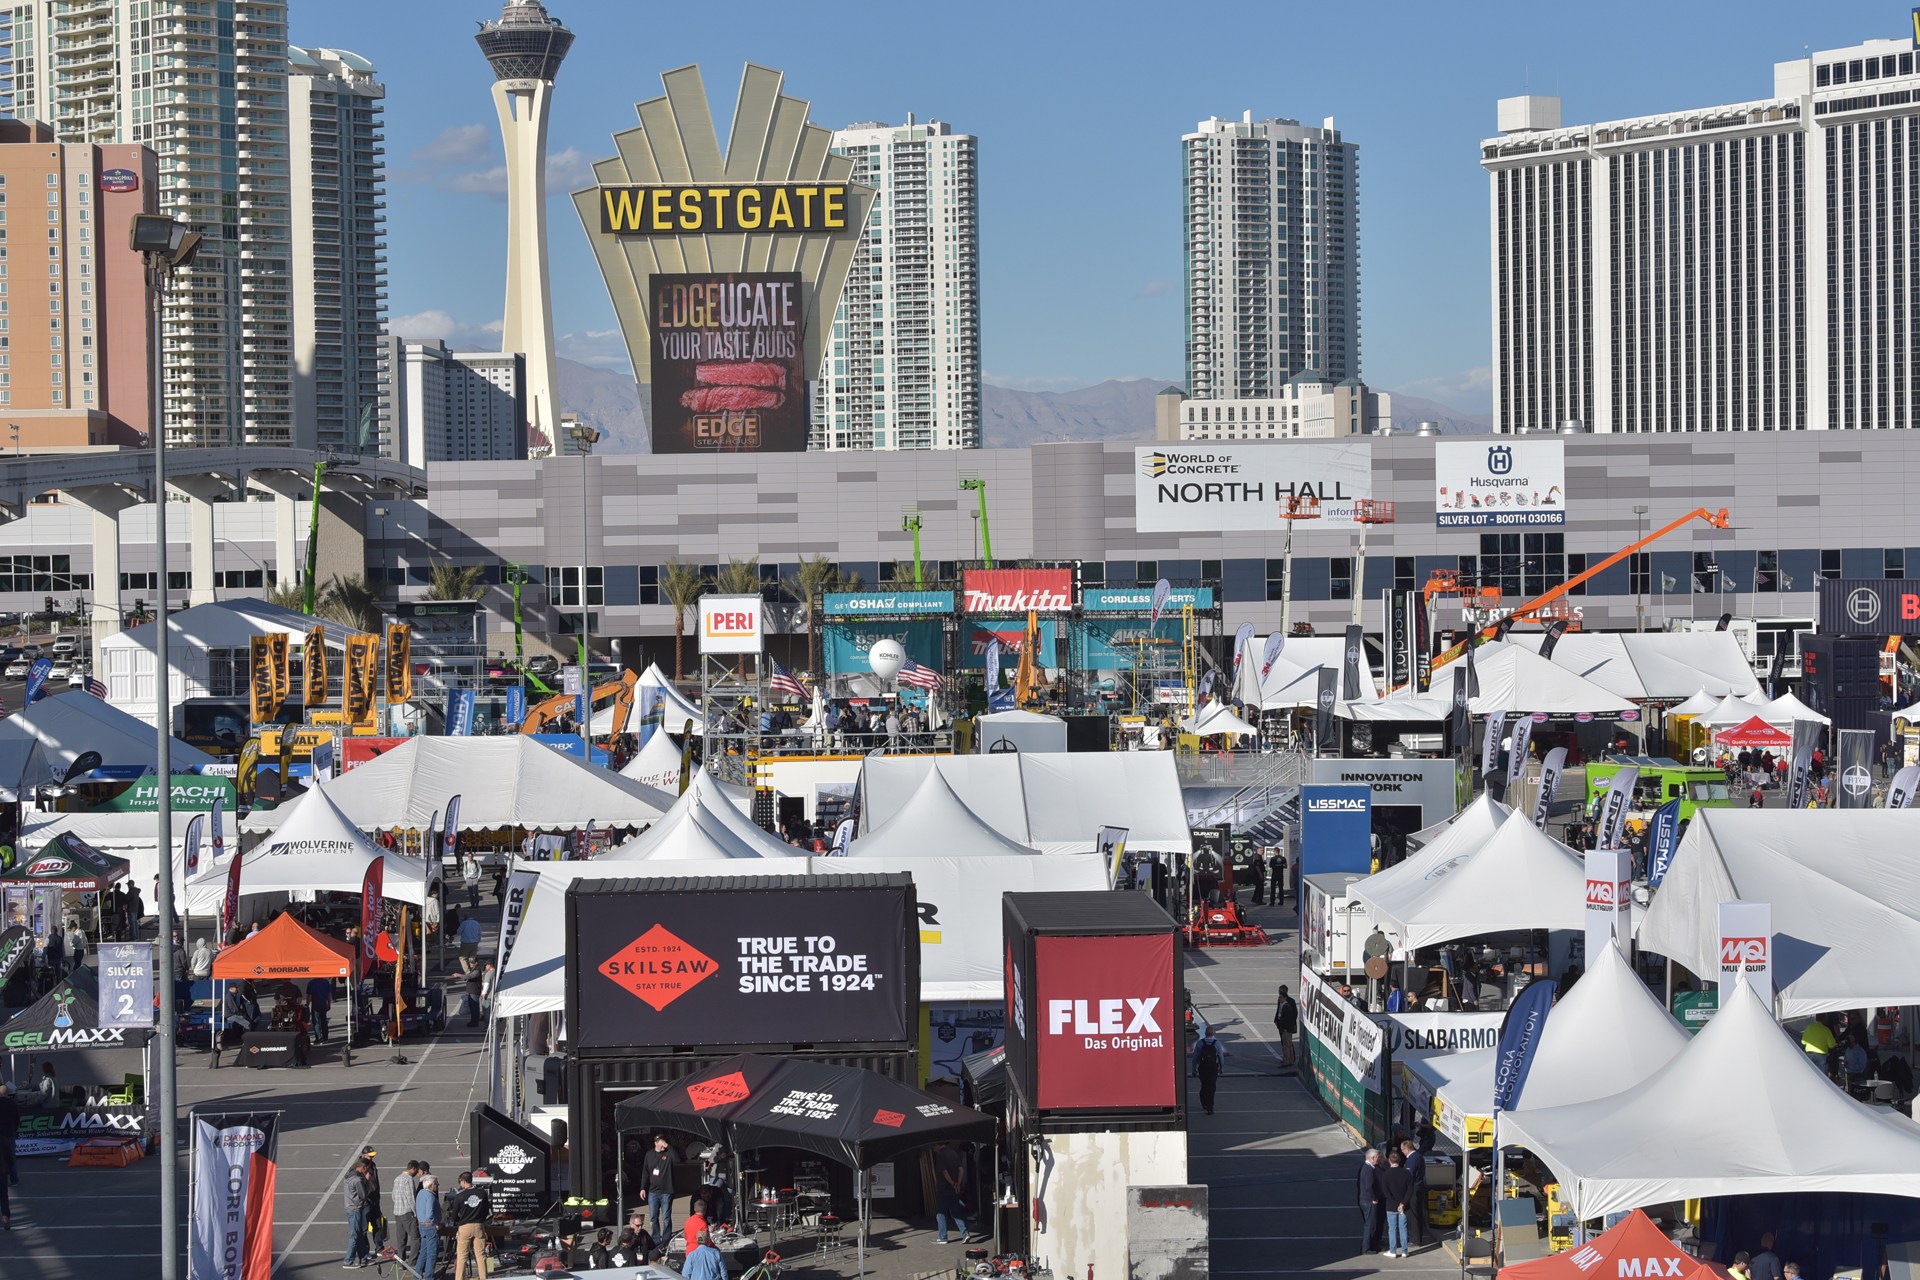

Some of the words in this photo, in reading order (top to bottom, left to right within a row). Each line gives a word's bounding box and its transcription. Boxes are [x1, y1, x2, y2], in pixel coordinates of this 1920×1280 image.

[604, 187, 845, 231] WESTGATE
[658, 281, 796, 328] EDGEUCATE
[660, 332, 700, 360] YOUR
[705, 331, 750, 360] TASTE
[756, 330, 796, 359] BUDS
[697, 418, 758, 437] EDGE
[697, 438, 758, 446] STEAKHOUSE
[1167, 454, 1214, 464] WORLD
[1470, 477, 1529, 488] Husqvarna
[1158, 482, 1263, 503] NORTH
[1275, 481, 1352, 501] HALL
[1440, 515, 1469, 525] SILVER
[1472, 514, 1488, 524] LOT
[1496, 514, 1526, 524] BOOTH
[1528, 514, 1562, 523] 030166
[850, 600, 882, 609] OSHA
[1101, 596, 1150, 604] CORDLESS
[1164, 594, 1196, 602] PERTS
[427, 606, 458, 614] MERLO
[713, 612, 754, 631] PERI
[1234, 654, 1242, 666] 3M
[1262, 662, 1271, 676] 3M
[275, 736, 318, 745] DWALT
[1340, 773, 1423, 782] INNOVATION
[1848, 776, 1866, 785] HTC
[135, 786, 226, 798] HIACHI
[1308, 799, 1366, 809] LISSMAC
[289, 840, 354, 850] WOLVERINE
[27, 862, 70, 874] INDY
[1586, 903, 1614, 912] MULTIQUIP
[737, 936, 798, 955] TRUE
[804, 936, 836, 954] TO
[107, 966, 144, 976] SILVER
[608, 960, 708, 975] SKILSAW
[738, 956, 783, 974] THE
[789, 954, 868, 973] TRADE
[116, 980, 136, 990] LOT
[738, 975, 811, 994] SINCE
[117, 994, 134, 1015] 2
[1048, 997, 1162, 1035] FLEX
[1084, 1037, 1106, 1050] Das
[1112, 1034, 1164, 1052] Original
[1404, 1027, 1500, 1050] SLABARMO
[1504, 1010, 1539, 1102] CORPORATION
[1494, 1050, 1516, 1100] PECORA
[690, 1085, 748, 1100] SKILSAW
[788, 1090, 816, 1100] TRUE
[816, 1094, 833, 1102] TO
[770, 1105, 803, 1116] SINCE
[778, 1098, 800, 1108] THE
[802, 1100, 839, 1112] TRADE
[224, 1134, 264, 1142] DIAMOND
[226, 1164, 244, 1224] CORE
[224, 1232, 238, 1280] BOR
[1569, 1245, 1604, 1272] MAX
[1618, 1257, 1684, 1278] MAX
